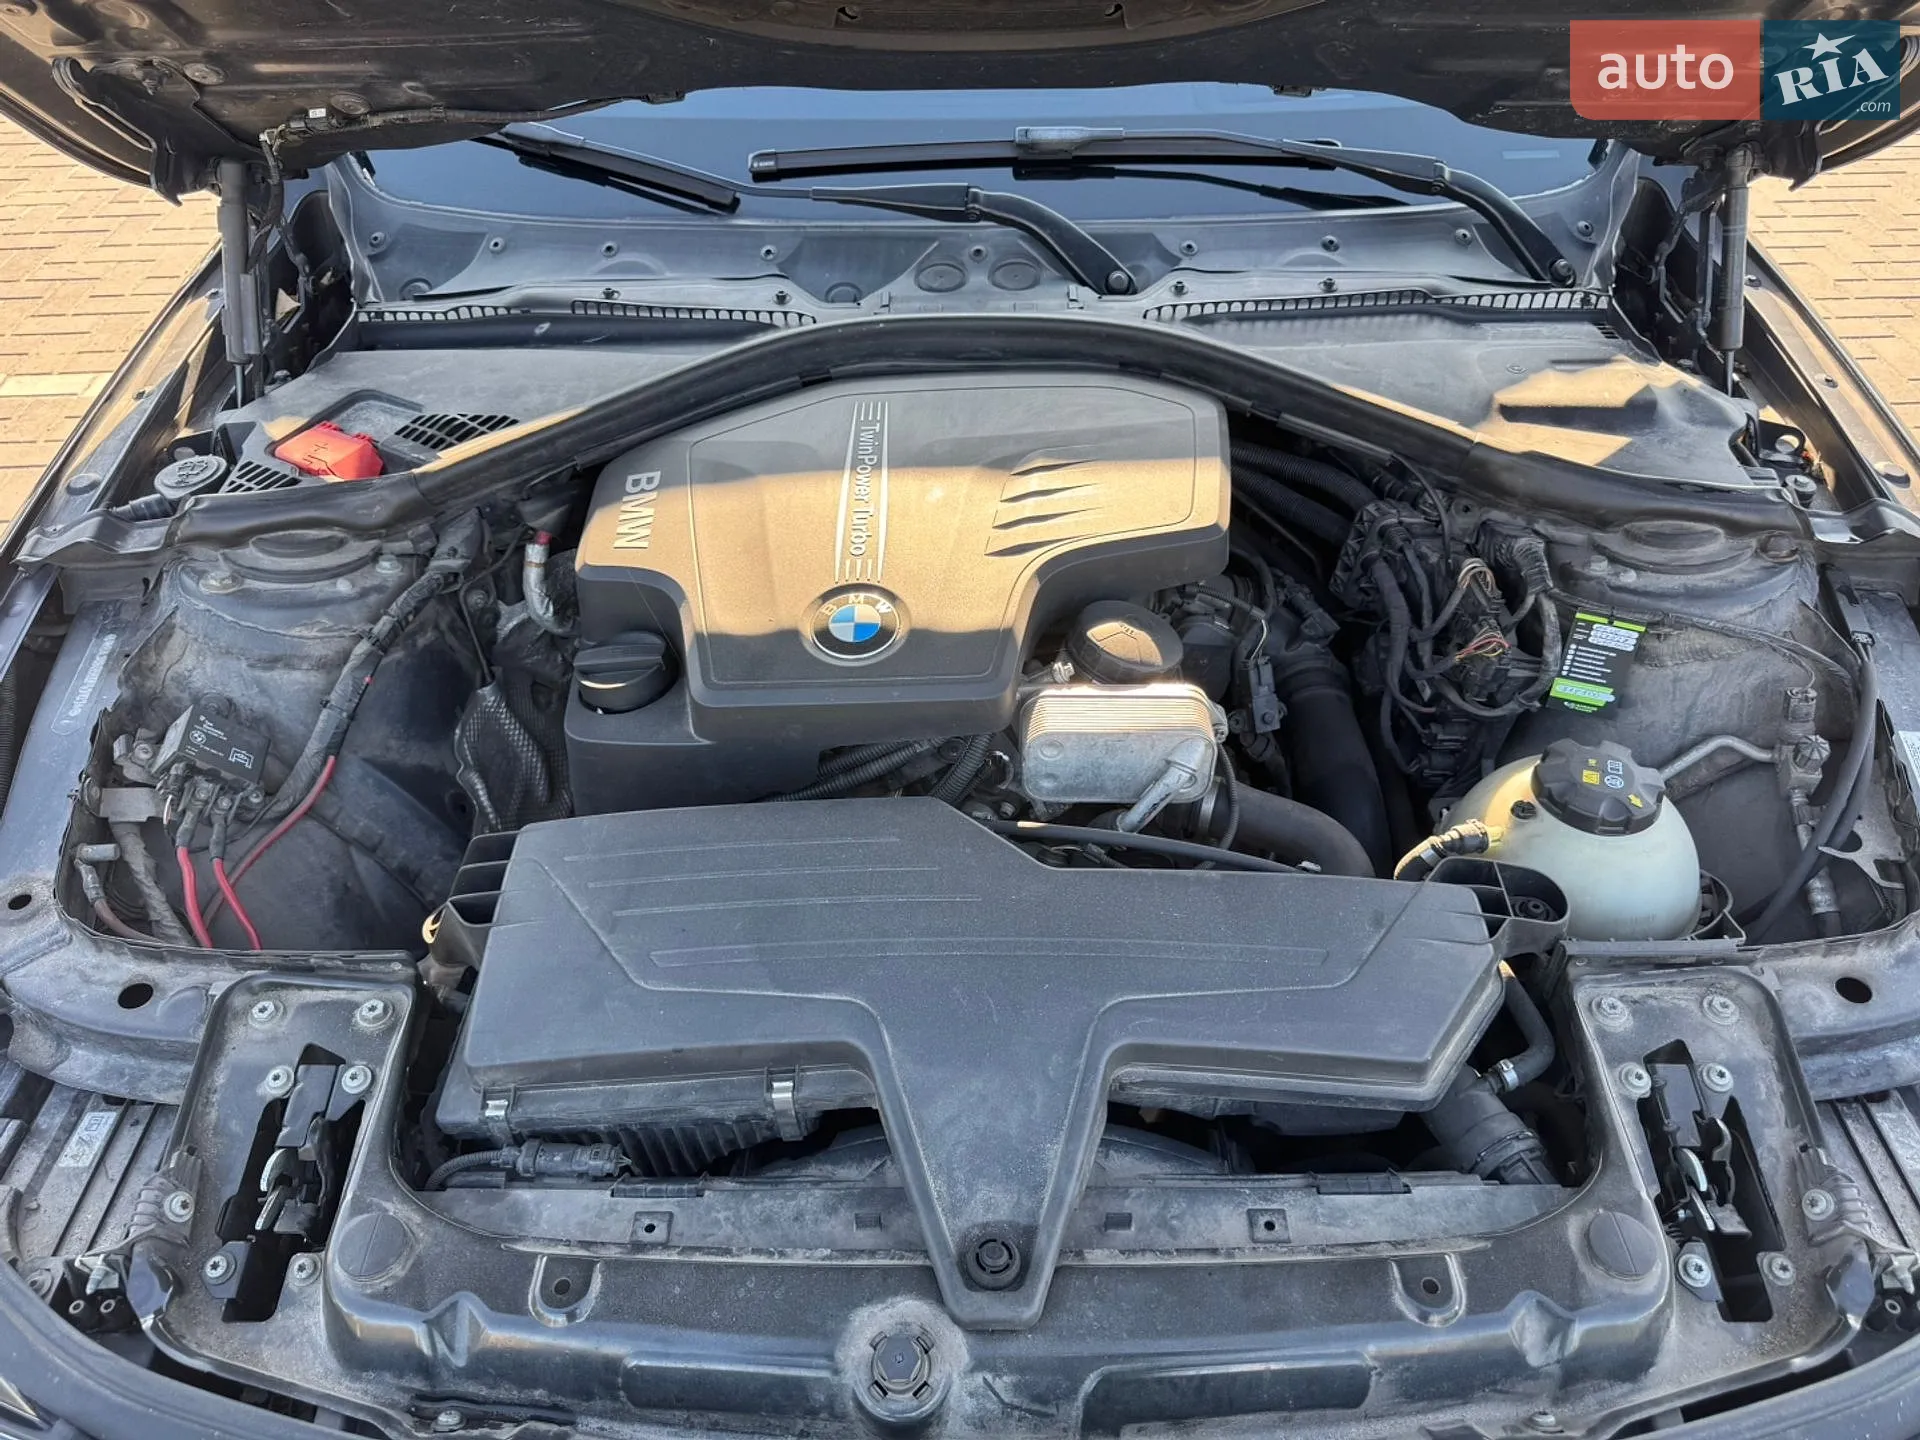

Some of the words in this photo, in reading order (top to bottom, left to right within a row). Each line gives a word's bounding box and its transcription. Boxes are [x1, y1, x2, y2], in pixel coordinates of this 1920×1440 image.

[854, 423, 881, 504] TwinPower
[612, 470, 662, 550] BMW
[850, 506, 875, 557] Turbo
[820, 594, 892, 615] BMW
